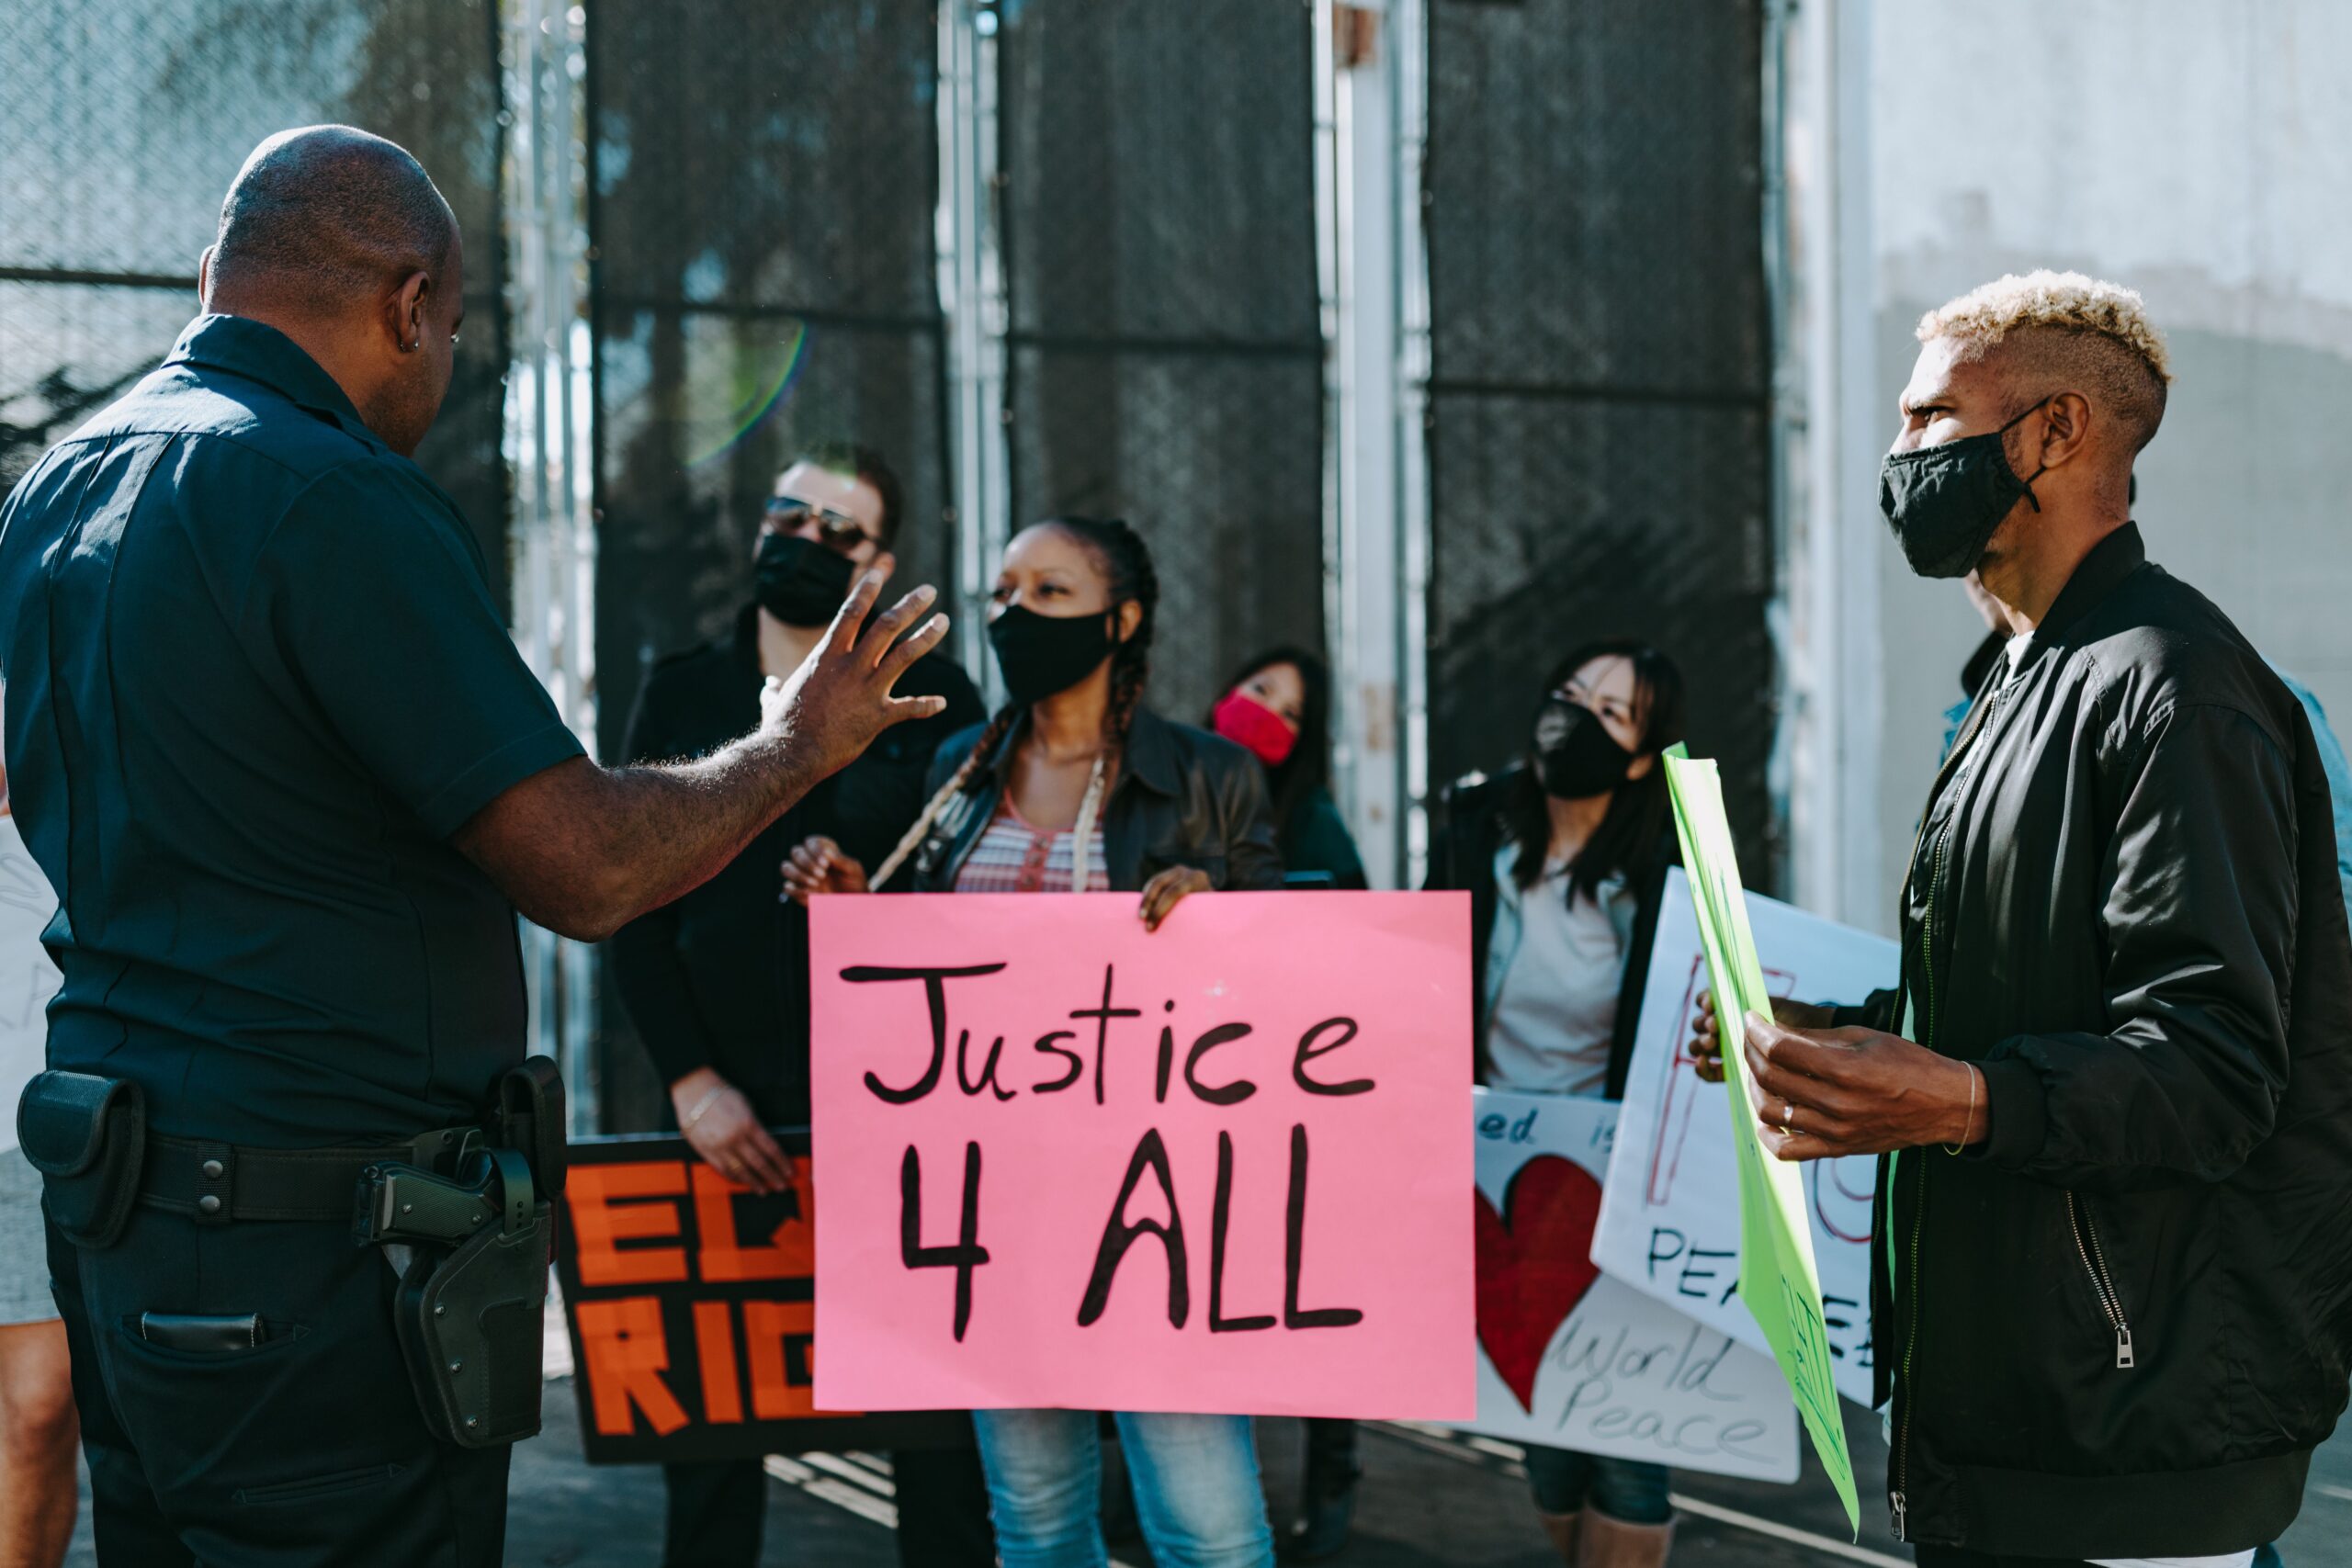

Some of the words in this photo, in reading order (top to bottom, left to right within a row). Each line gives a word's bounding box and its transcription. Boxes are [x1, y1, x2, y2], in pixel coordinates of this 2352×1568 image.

[839, 962, 1376, 1105] Justice
[900, 1140, 990, 1343] 4
[1077, 1122, 1364, 1334] ALL
[1553, 1316, 1744, 1402] World
[1555, 1376, 1781, 1465] Peace
